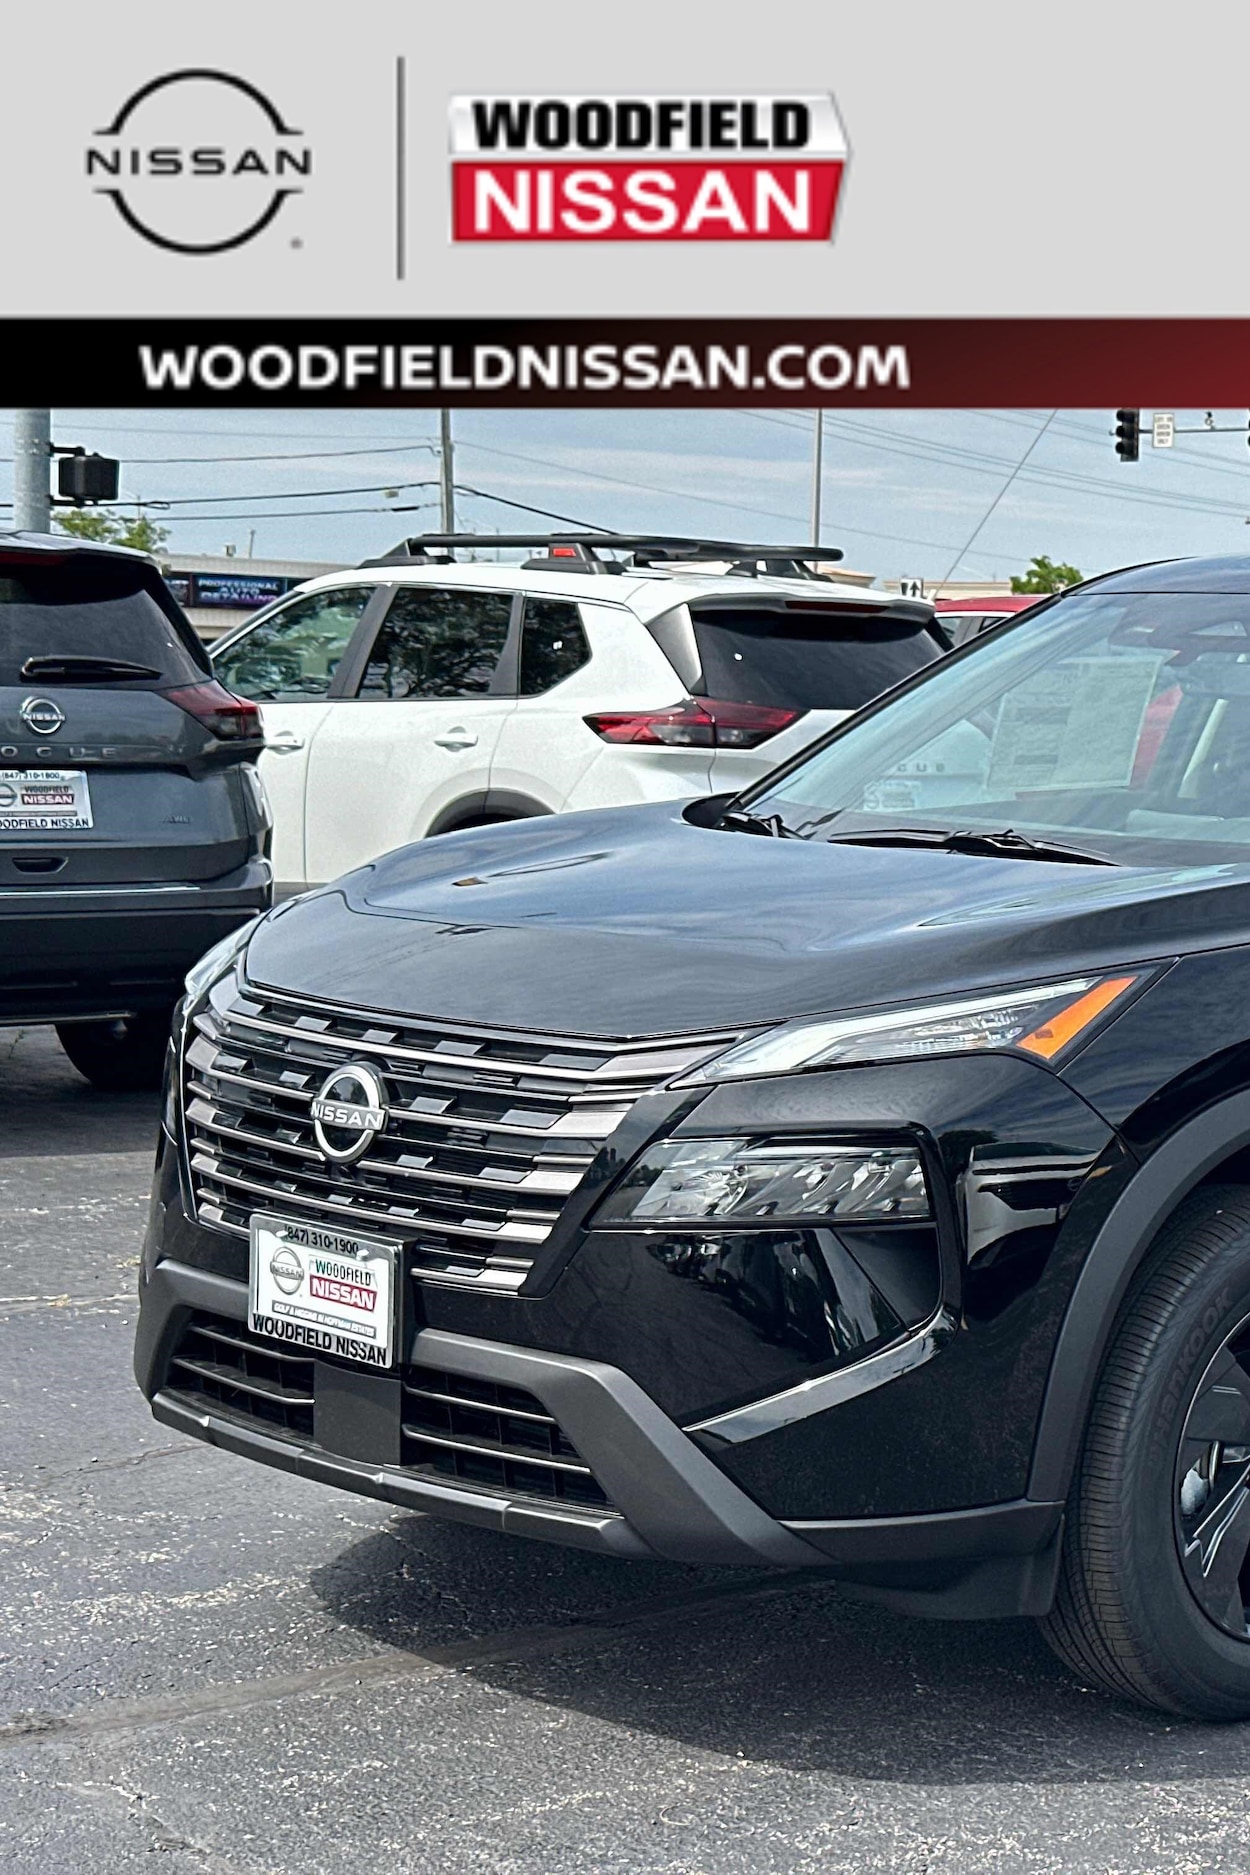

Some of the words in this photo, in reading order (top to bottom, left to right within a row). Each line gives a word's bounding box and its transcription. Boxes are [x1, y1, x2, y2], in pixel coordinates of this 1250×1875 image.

[199, 578, 278, 590] PROFESSIONAL
[220, 586, 260, 595] AUTO
[23, 795, 73, 804] NISSAN
[51, 818, 89, 828] NISSAN
[311, 1101, 380, 1128] NISSAN
[284, 1225, 308, 1245] (847)
[311, 1231, 359, 1255] 310-1900
[315, 1259, 371, 1287] WOODFIELD
[311, 1278, 375, 1310] NISSAN
[253, 1313, 332, 1350] WOODFIELD
[336, 1336, 387, 1366] NISSAN
